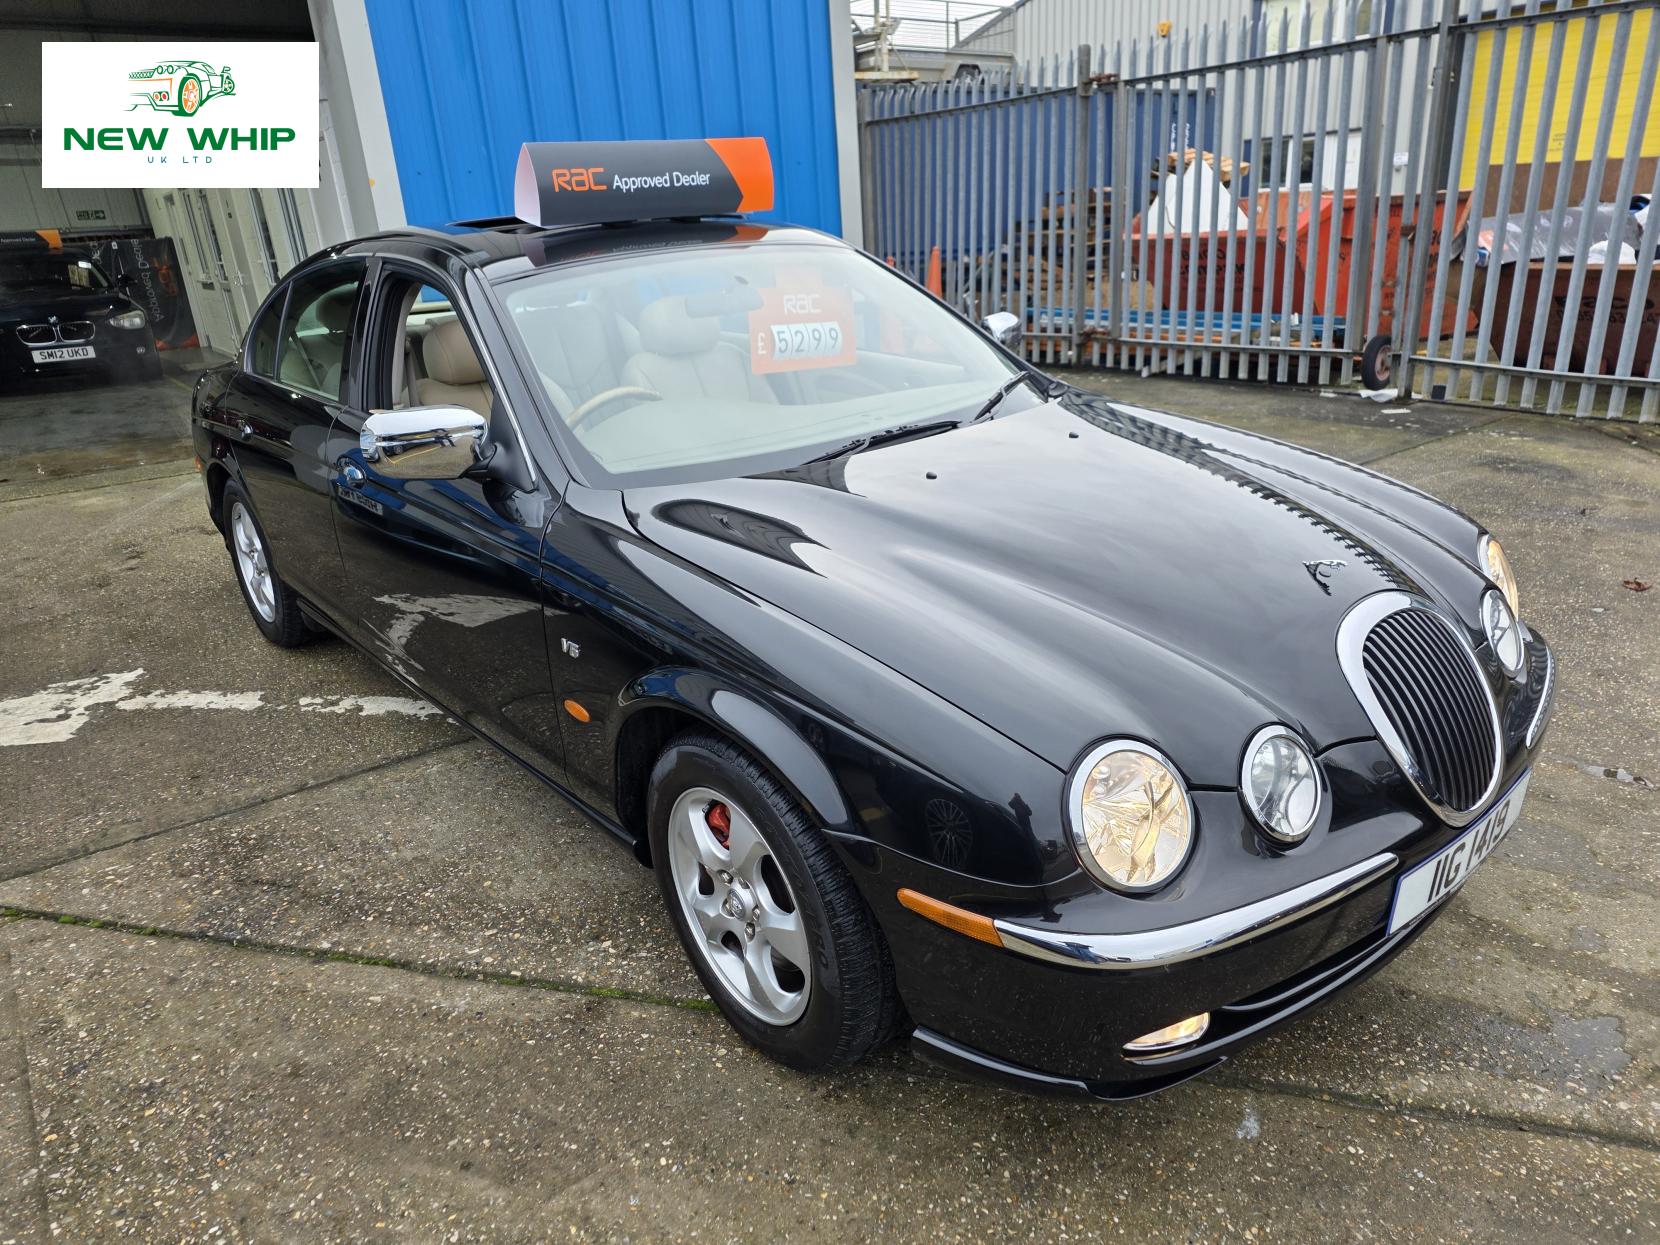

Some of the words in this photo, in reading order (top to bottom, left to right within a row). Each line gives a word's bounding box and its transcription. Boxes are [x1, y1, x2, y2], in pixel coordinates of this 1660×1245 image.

[612, 172, 670, 193] Approved
[672, 171, 711, 187] Dealer
[757, 332, 767, 355] £
[776, 327, 839, 353] 5299
[67, 347, 89, 358] UKD
[561, 637, 579, 659] V6
